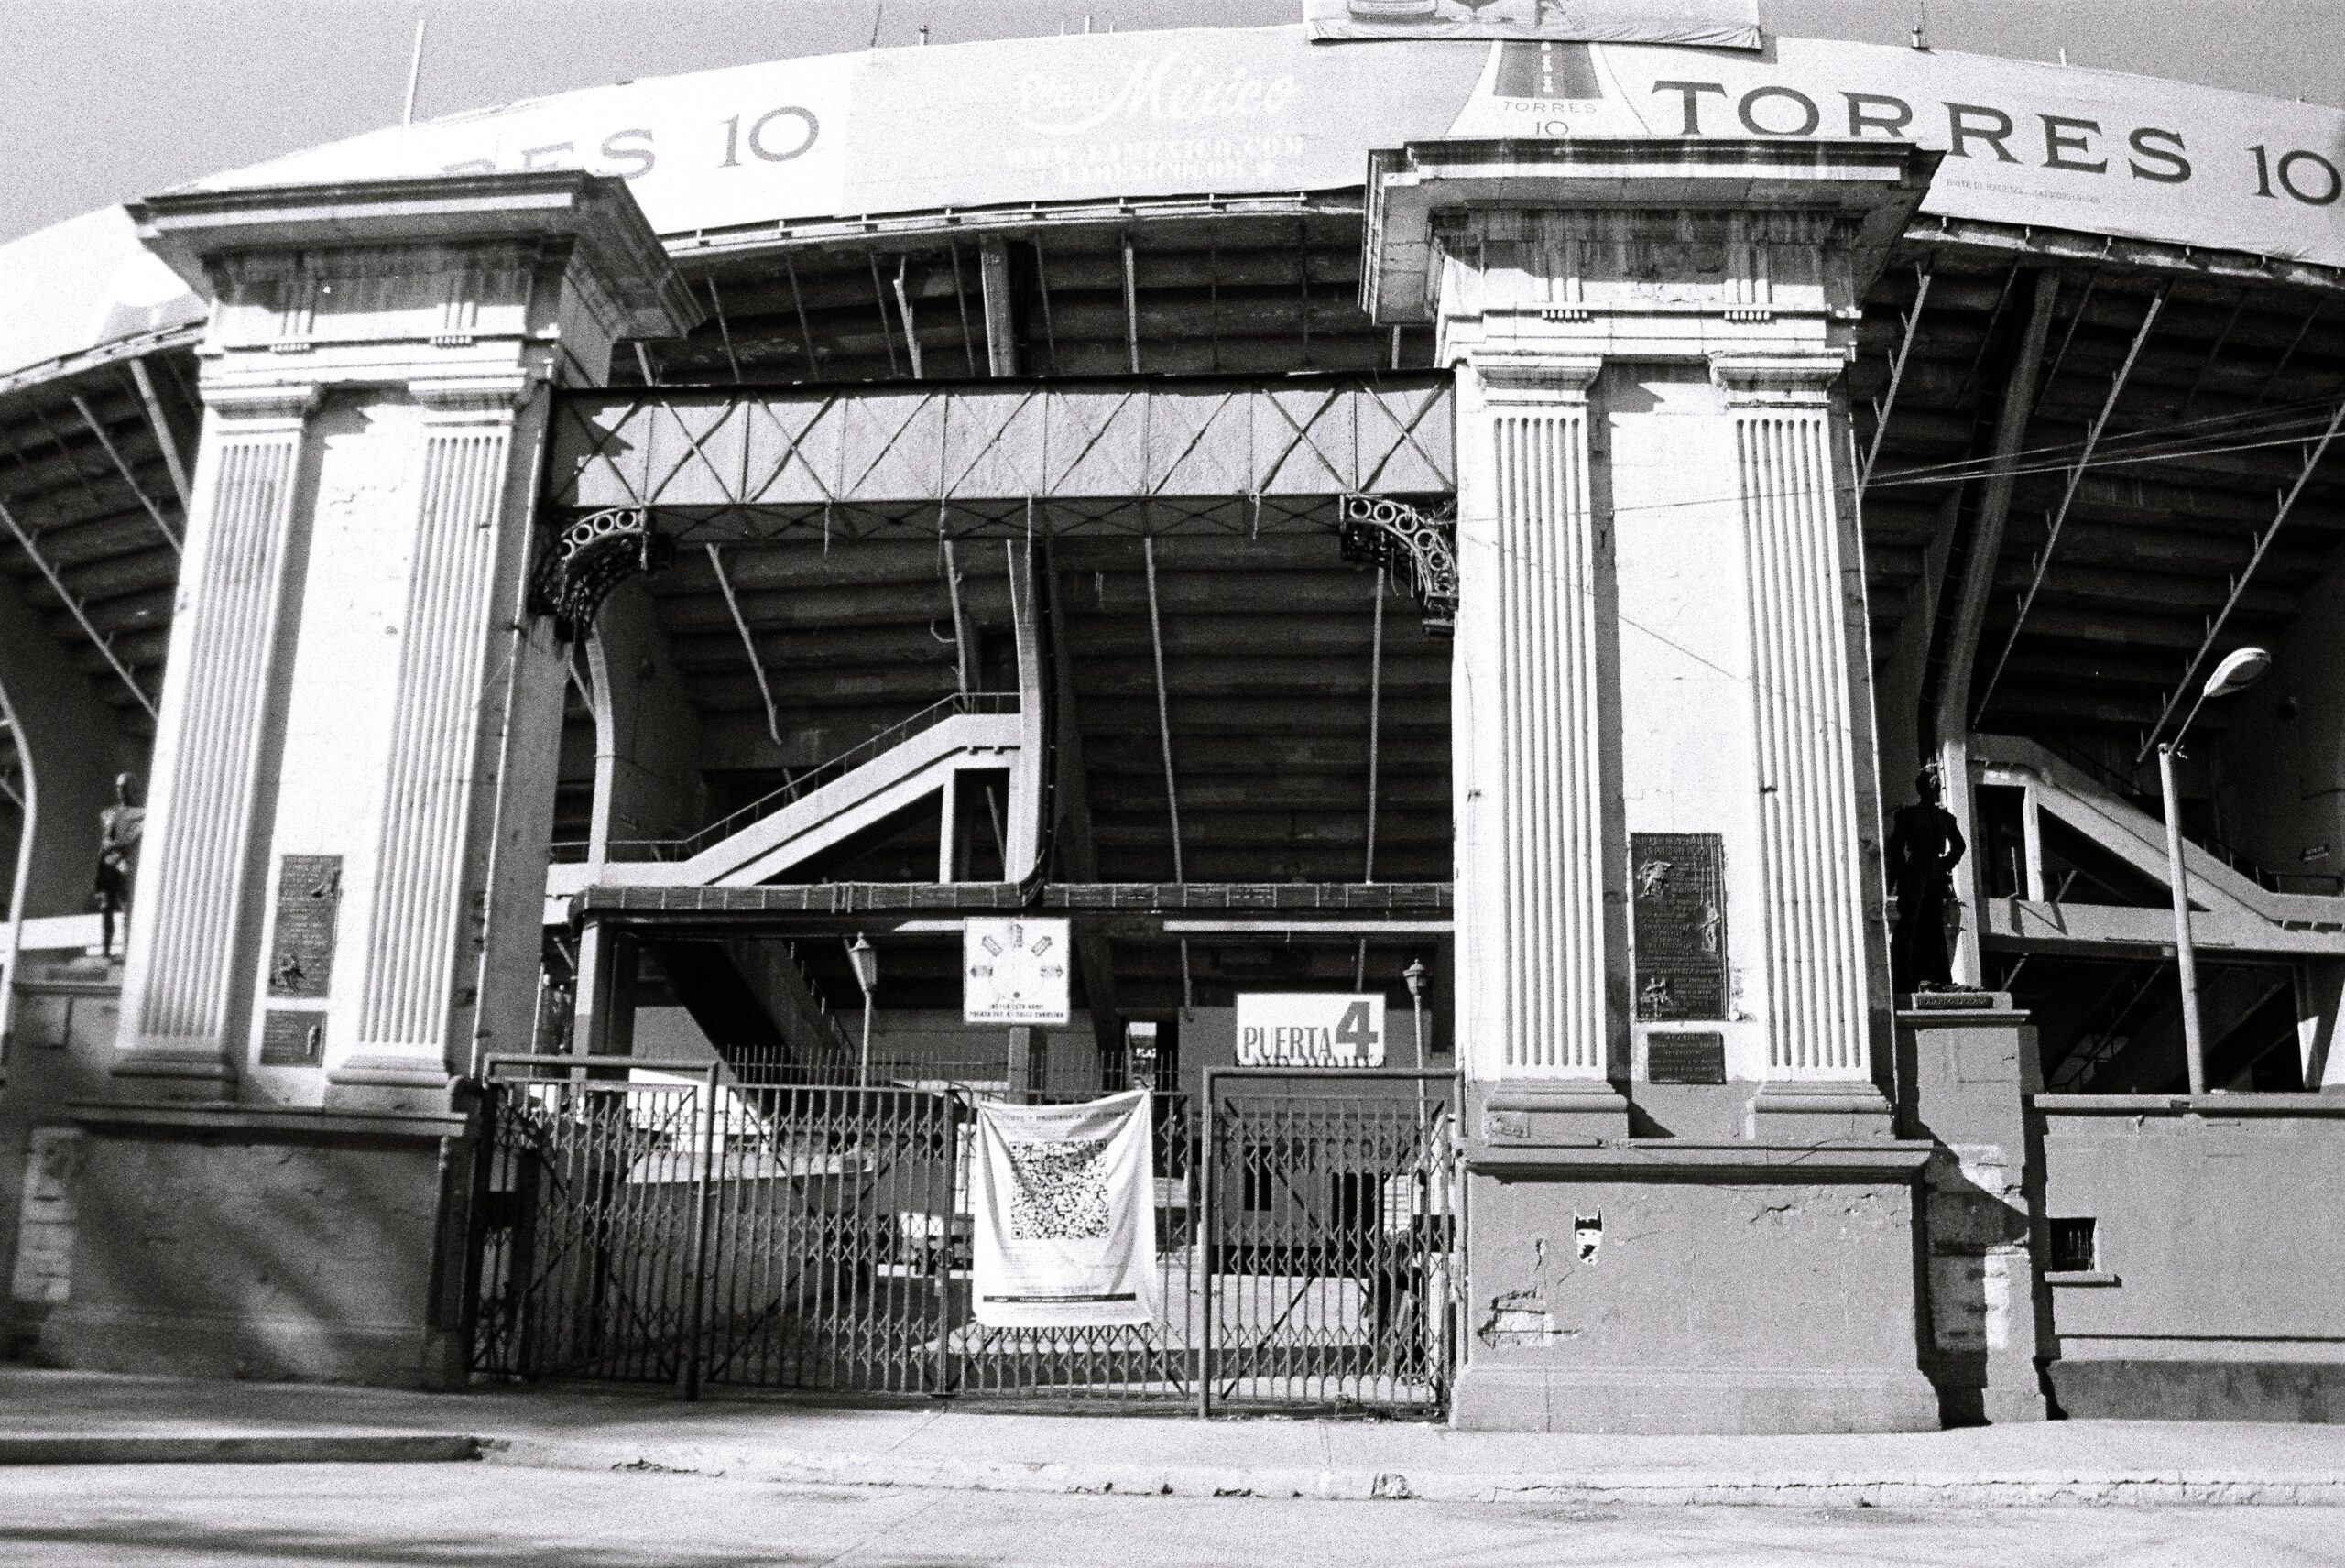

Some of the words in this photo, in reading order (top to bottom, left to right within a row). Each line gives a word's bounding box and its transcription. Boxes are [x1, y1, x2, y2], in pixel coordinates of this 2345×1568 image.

[718, 105, 820, 169] 10
[1503, 101, 1598, 114] TORRES
[1535, 120, 1569, 136] 10
[1652, 80, 2191, 183] TORRES
[2247, 144, 2343, 206] 10
[1243, 1026, 1332, 1060] PUERTA
[1336, 1001, 1378, 1059] 4
